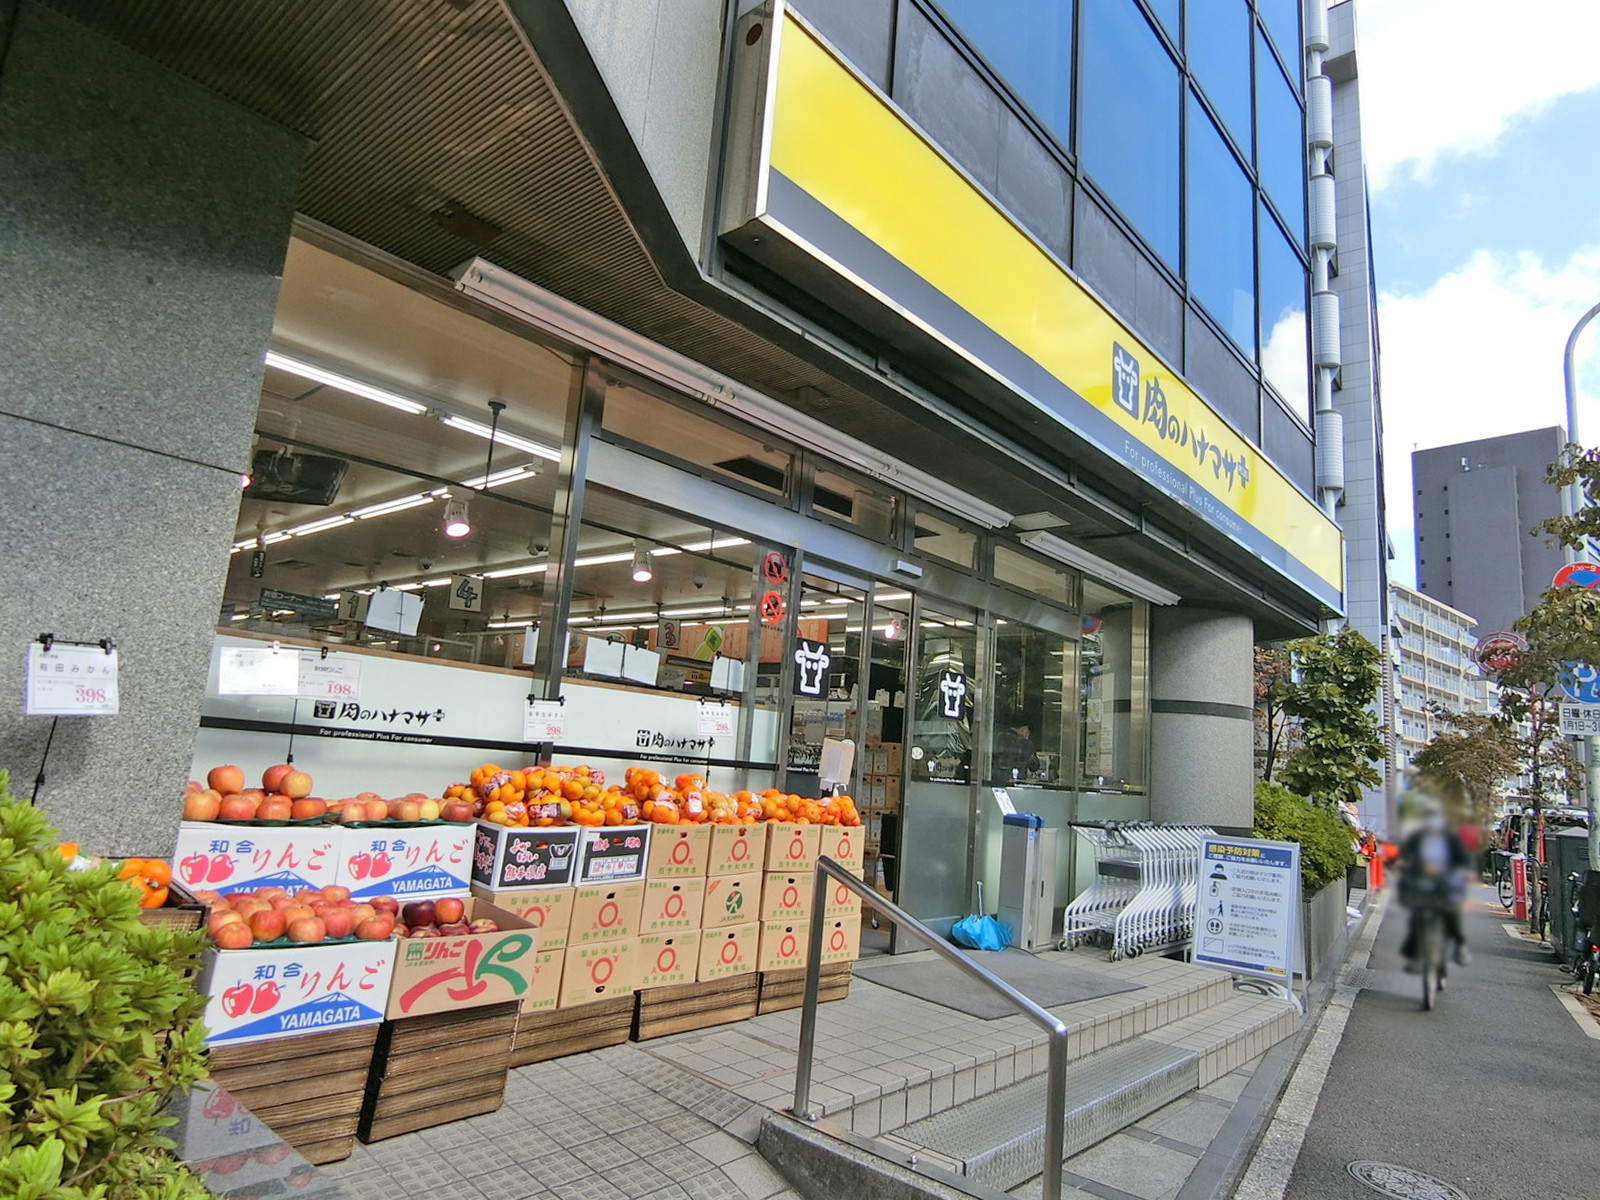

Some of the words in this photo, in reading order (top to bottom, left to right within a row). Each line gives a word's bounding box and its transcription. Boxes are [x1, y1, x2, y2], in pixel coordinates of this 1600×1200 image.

[1142, 376, 1237, 493] 肉のハナマサ
[1124, 439, 1139, 460] For
[1141, 456, 1188, 496] professional
[457, 579, 478, 608] 4
[75, 688, 107, 703] 398
[327, 683, 353, 696] 198
[337, 701, 432, 728] 肉のハナマサ
[333, 730, 375, 740] professional
[651, 732, 706, 751] 肉のハナマサ
[209, 839, 255, 854] 和合
[252, 842, 332, 873] りんご
[371, 839, 407, 853] 和合
[405, 839, 469, 868] りんご
[392, 876, 453, 893] YAMAGATA
[423, 939, 467, 961] りんご
[254, 962, 304, 980] 和合
[300, 960, 386, 999] りんご
[279, 1005, 361, 1030] YAMAGATA
